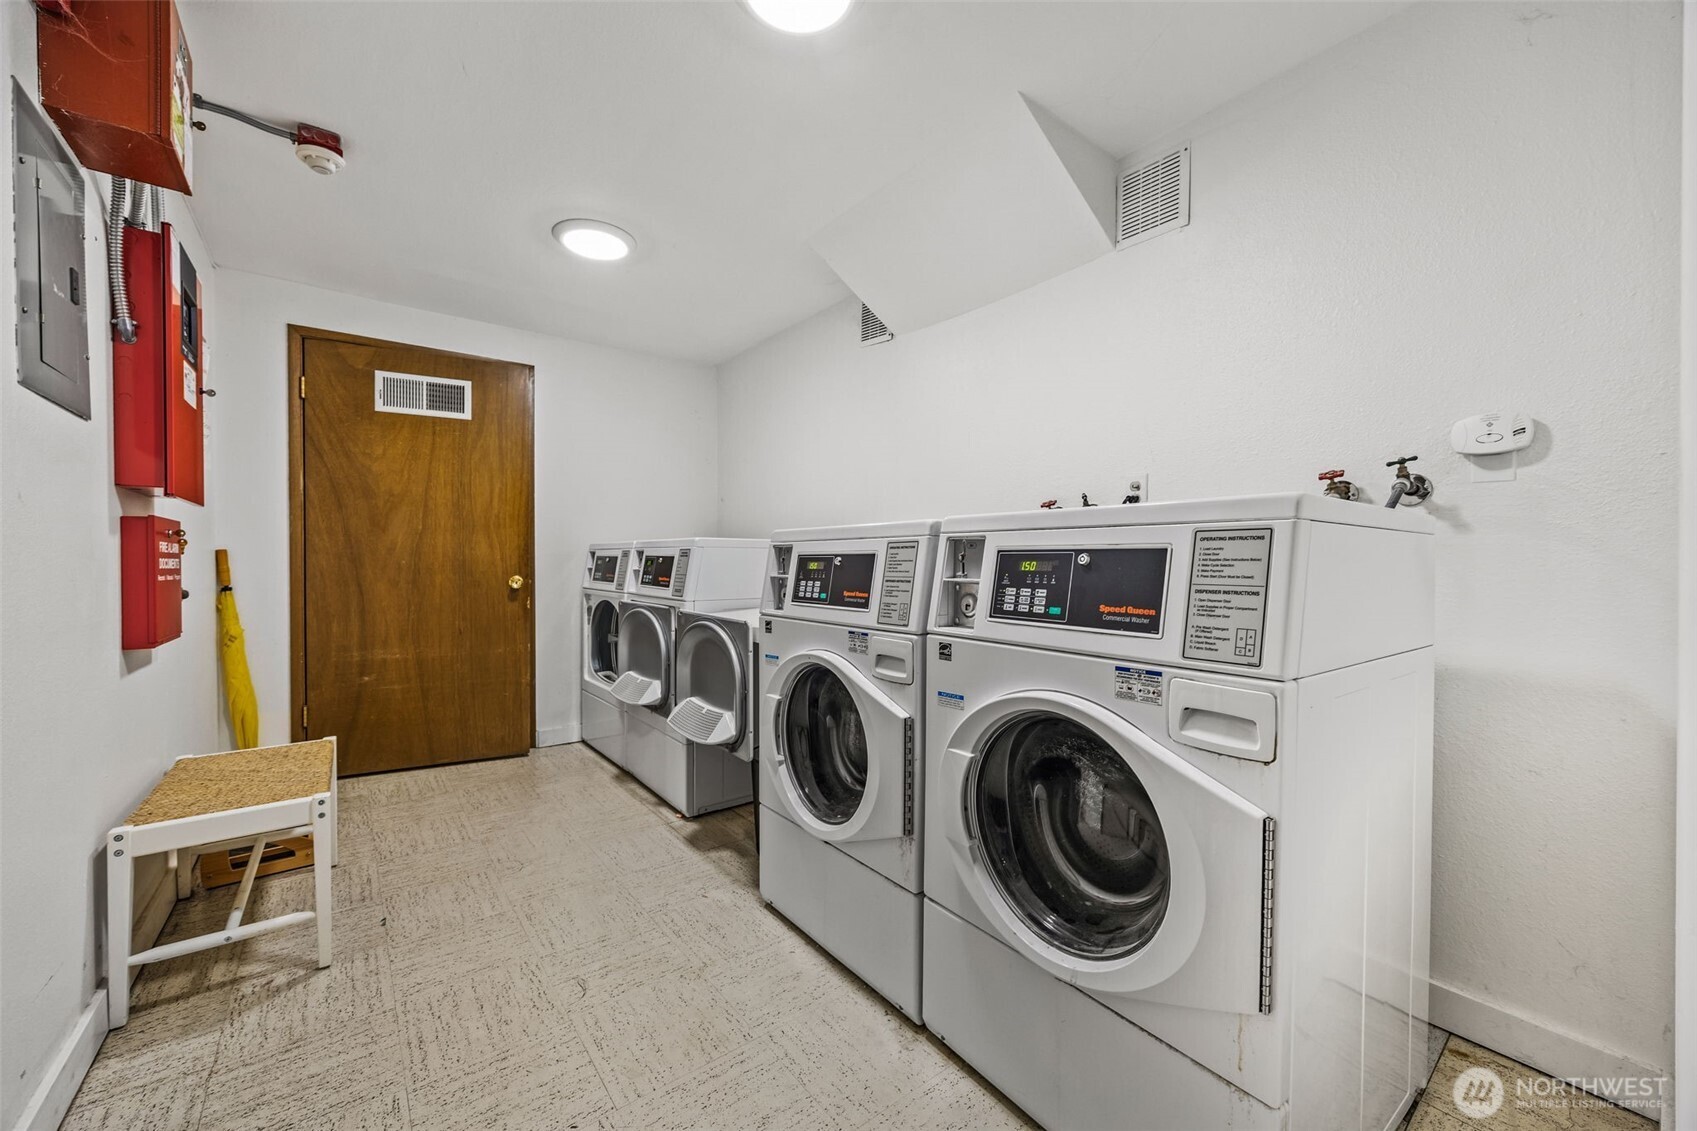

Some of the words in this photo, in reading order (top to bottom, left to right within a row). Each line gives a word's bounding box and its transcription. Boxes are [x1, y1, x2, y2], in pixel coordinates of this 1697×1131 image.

[159, 541, 168, 552] FIRE
[159, 558, 179, 569] DOCUMENTS
[1099, 604, 1126, 613] Speed
[1127, 606, 1156, 615] Queen
